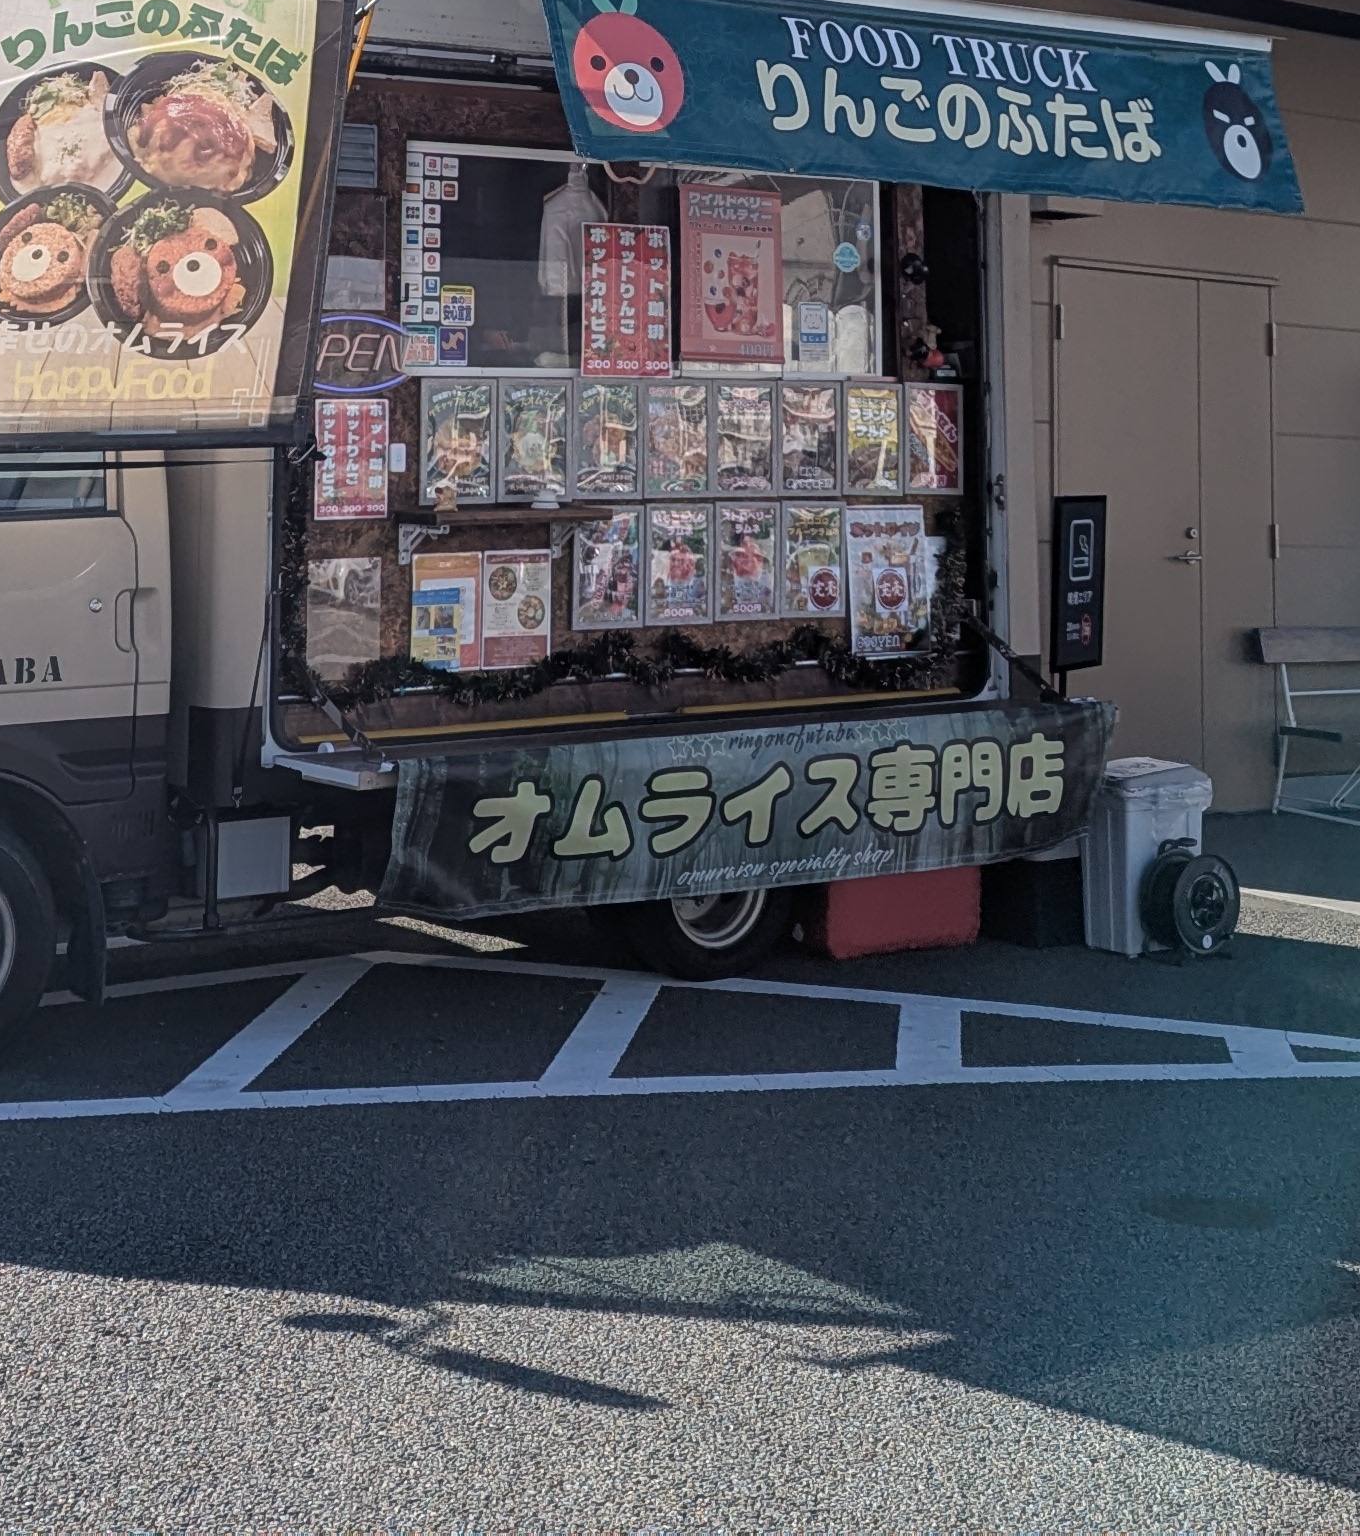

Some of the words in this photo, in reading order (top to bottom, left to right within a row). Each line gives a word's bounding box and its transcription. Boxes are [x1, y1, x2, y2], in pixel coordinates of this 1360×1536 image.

[781, 15, 920, 70] FOOD
[932, 34, 1098, 93] TRUCK
[755, 59, 1162, 163] りんごのふたば
[590, 227, 607, 350] ホットカルピス
[315, 333, 412, 372] PEN
[587, 360, 611, 369] 300
[616, 360, 639, 369] 300
[645, 361, 669, 370] 300
[728, 722, 857, 759] ringonofutaba
[468, 731, 1067, 863] オムライス専門店
